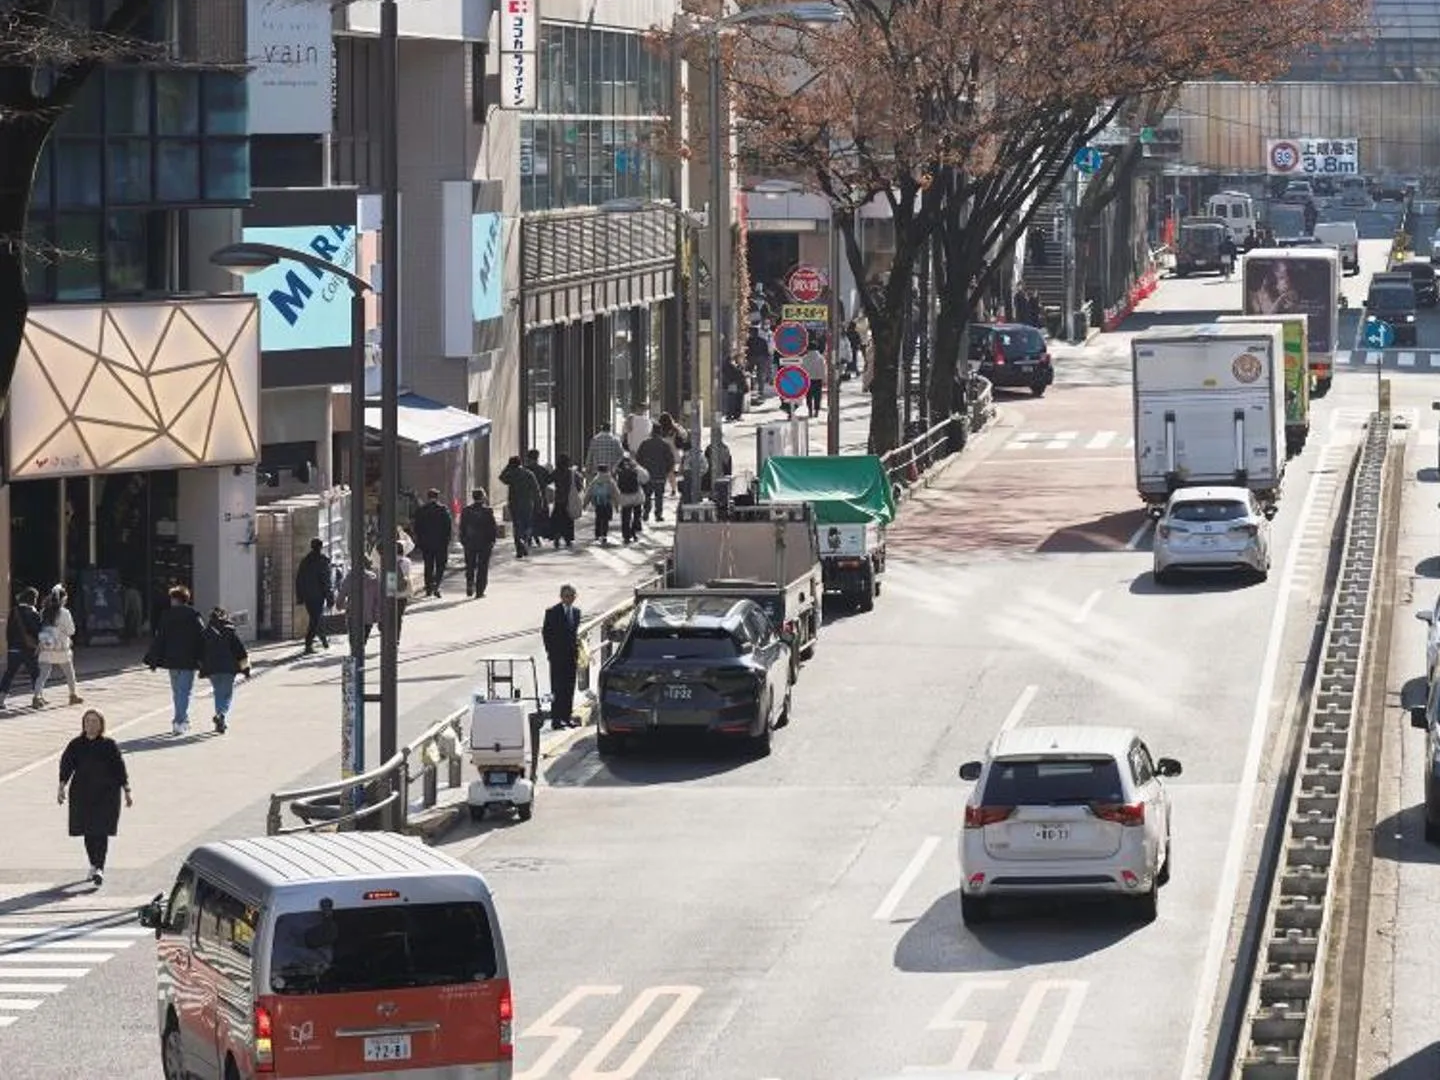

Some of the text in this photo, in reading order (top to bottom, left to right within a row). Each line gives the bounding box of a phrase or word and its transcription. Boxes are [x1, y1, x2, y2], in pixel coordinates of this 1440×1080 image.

[513, 17, 525, 106] ココカラファイン
[1303, 156, 1355, 173] 3.8m
[902, 979, 1090, 1071] 50
